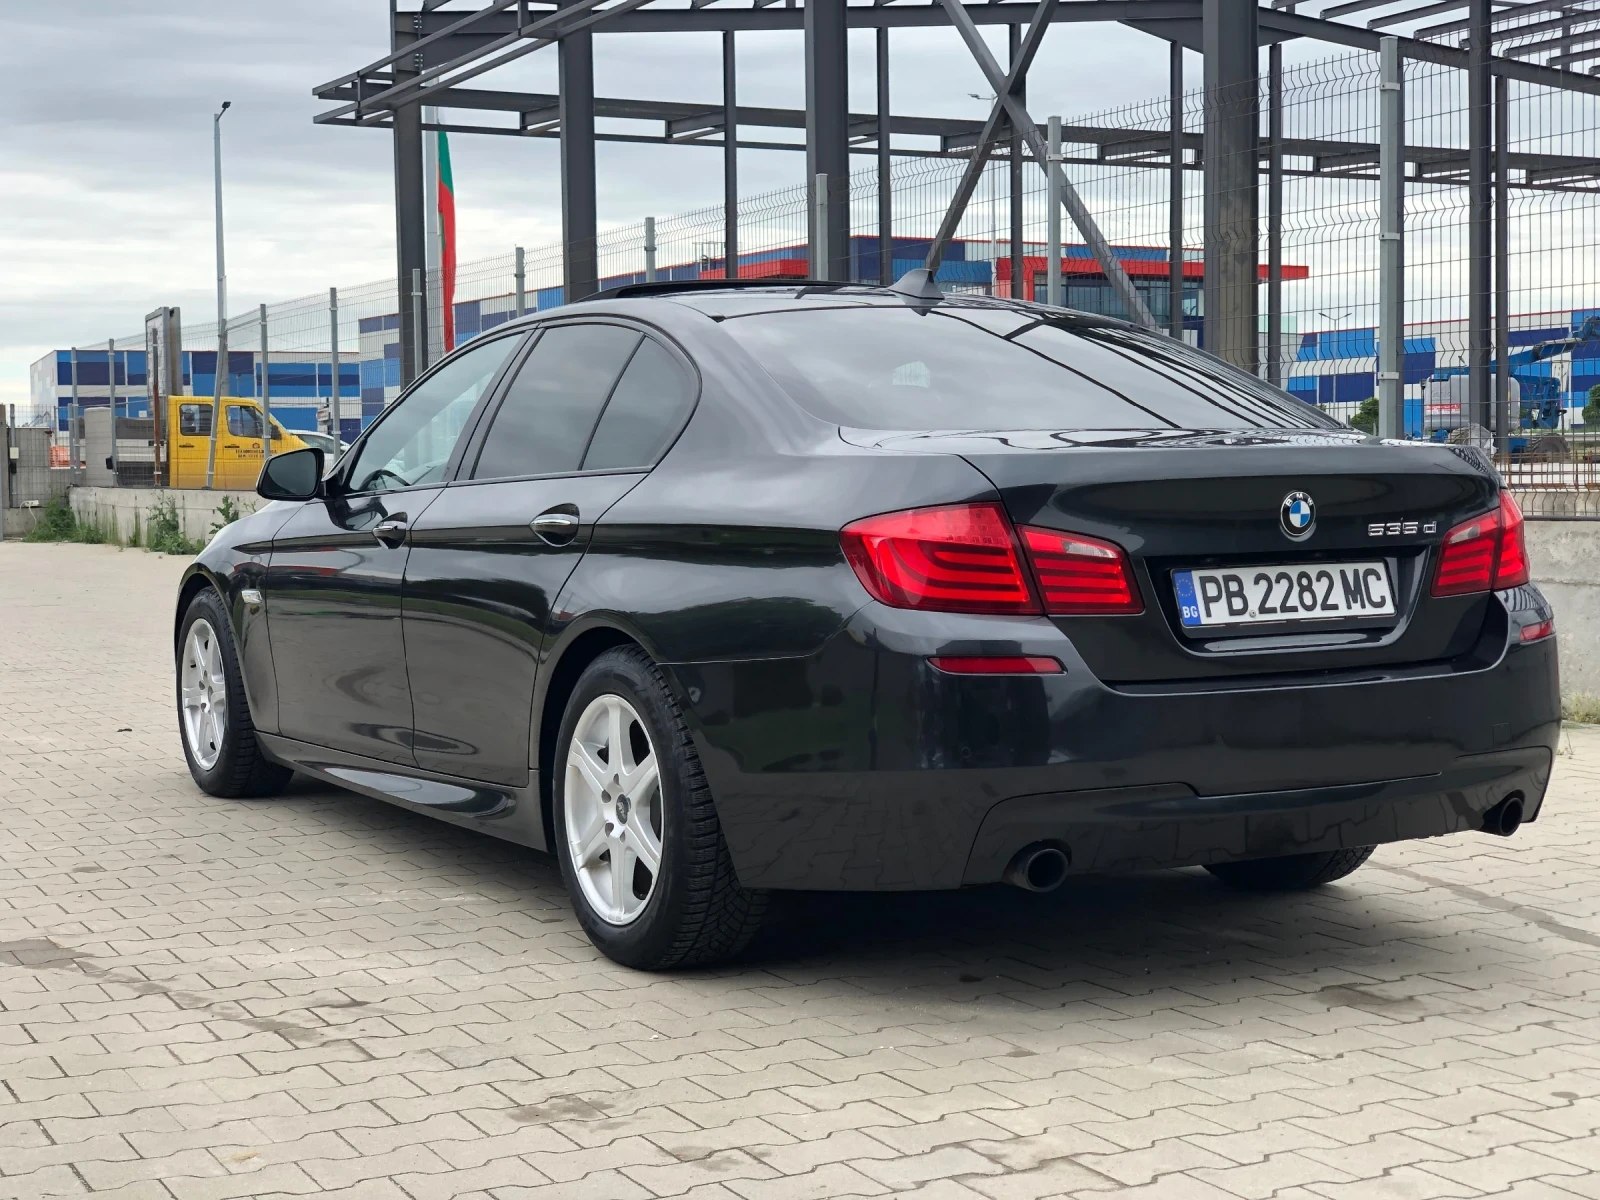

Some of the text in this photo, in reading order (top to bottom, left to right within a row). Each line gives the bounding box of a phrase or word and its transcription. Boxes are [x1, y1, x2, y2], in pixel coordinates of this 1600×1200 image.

[1285, 493, 1314, 507] BMW
[1198, 568, 1387, 618] PB 2282 MC
[1181, 605, 1199, 619] BG
